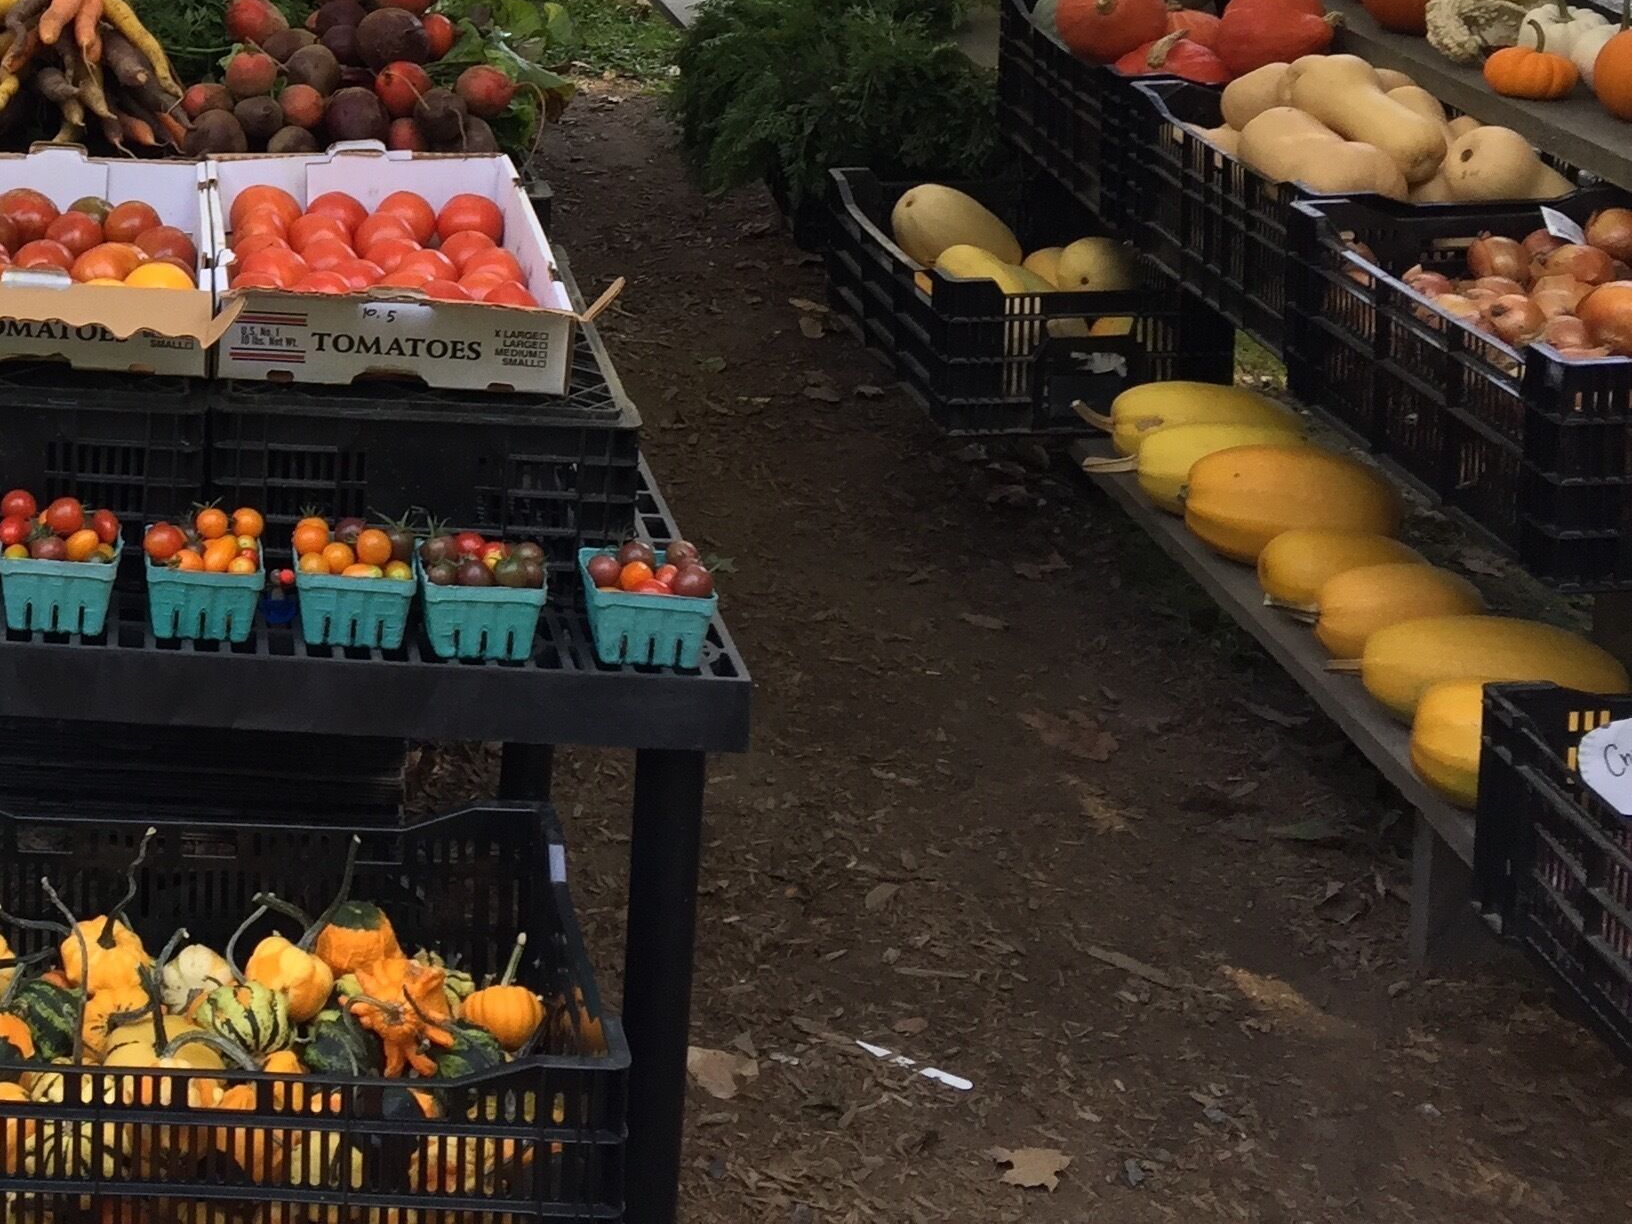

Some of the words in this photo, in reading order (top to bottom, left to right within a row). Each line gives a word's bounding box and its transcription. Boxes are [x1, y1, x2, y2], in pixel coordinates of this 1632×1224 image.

[504, 330, 539, 340] LARGE
[311, 331, 482, 361] TOMATOES
[503, 340, 538, 350] LARGE
[495, 347, 538, 358] MEDIUM
[502, 357, 538, 368] SMALL
